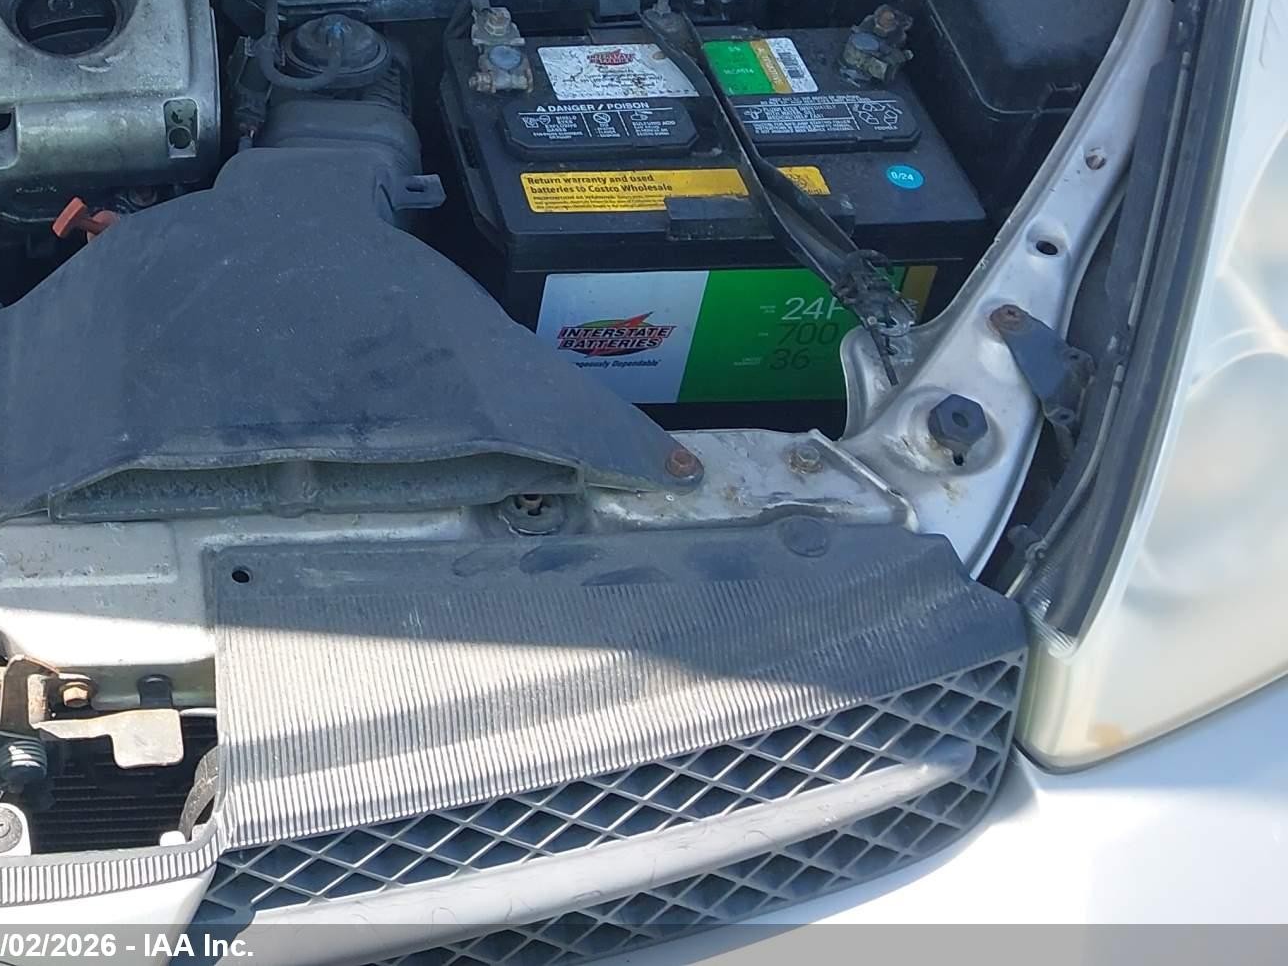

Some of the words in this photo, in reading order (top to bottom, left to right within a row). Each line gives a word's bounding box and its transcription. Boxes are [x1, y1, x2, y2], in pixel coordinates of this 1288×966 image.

[548, 104, 594, 112] DANGER
[606, 101, 649, 110] POISON
[527, 176, 561, 186] Return
[563, 177, 606, 188] warranty
[609, 175, 628, 184] and
[630, 175, 654, 183] used
[530, 185, 574, 194] batteries
[575, 184, 587, 193] to
[588, 184, 619, 192] Costco
[620, 182, 673, 192] Wholesale
[561, 327, 669, 338] INTERSTATE
[777, 322, 839, 345] 700
[563, 338, 658, 348] BATTERIES
[769, 348, 810, 370] 36
